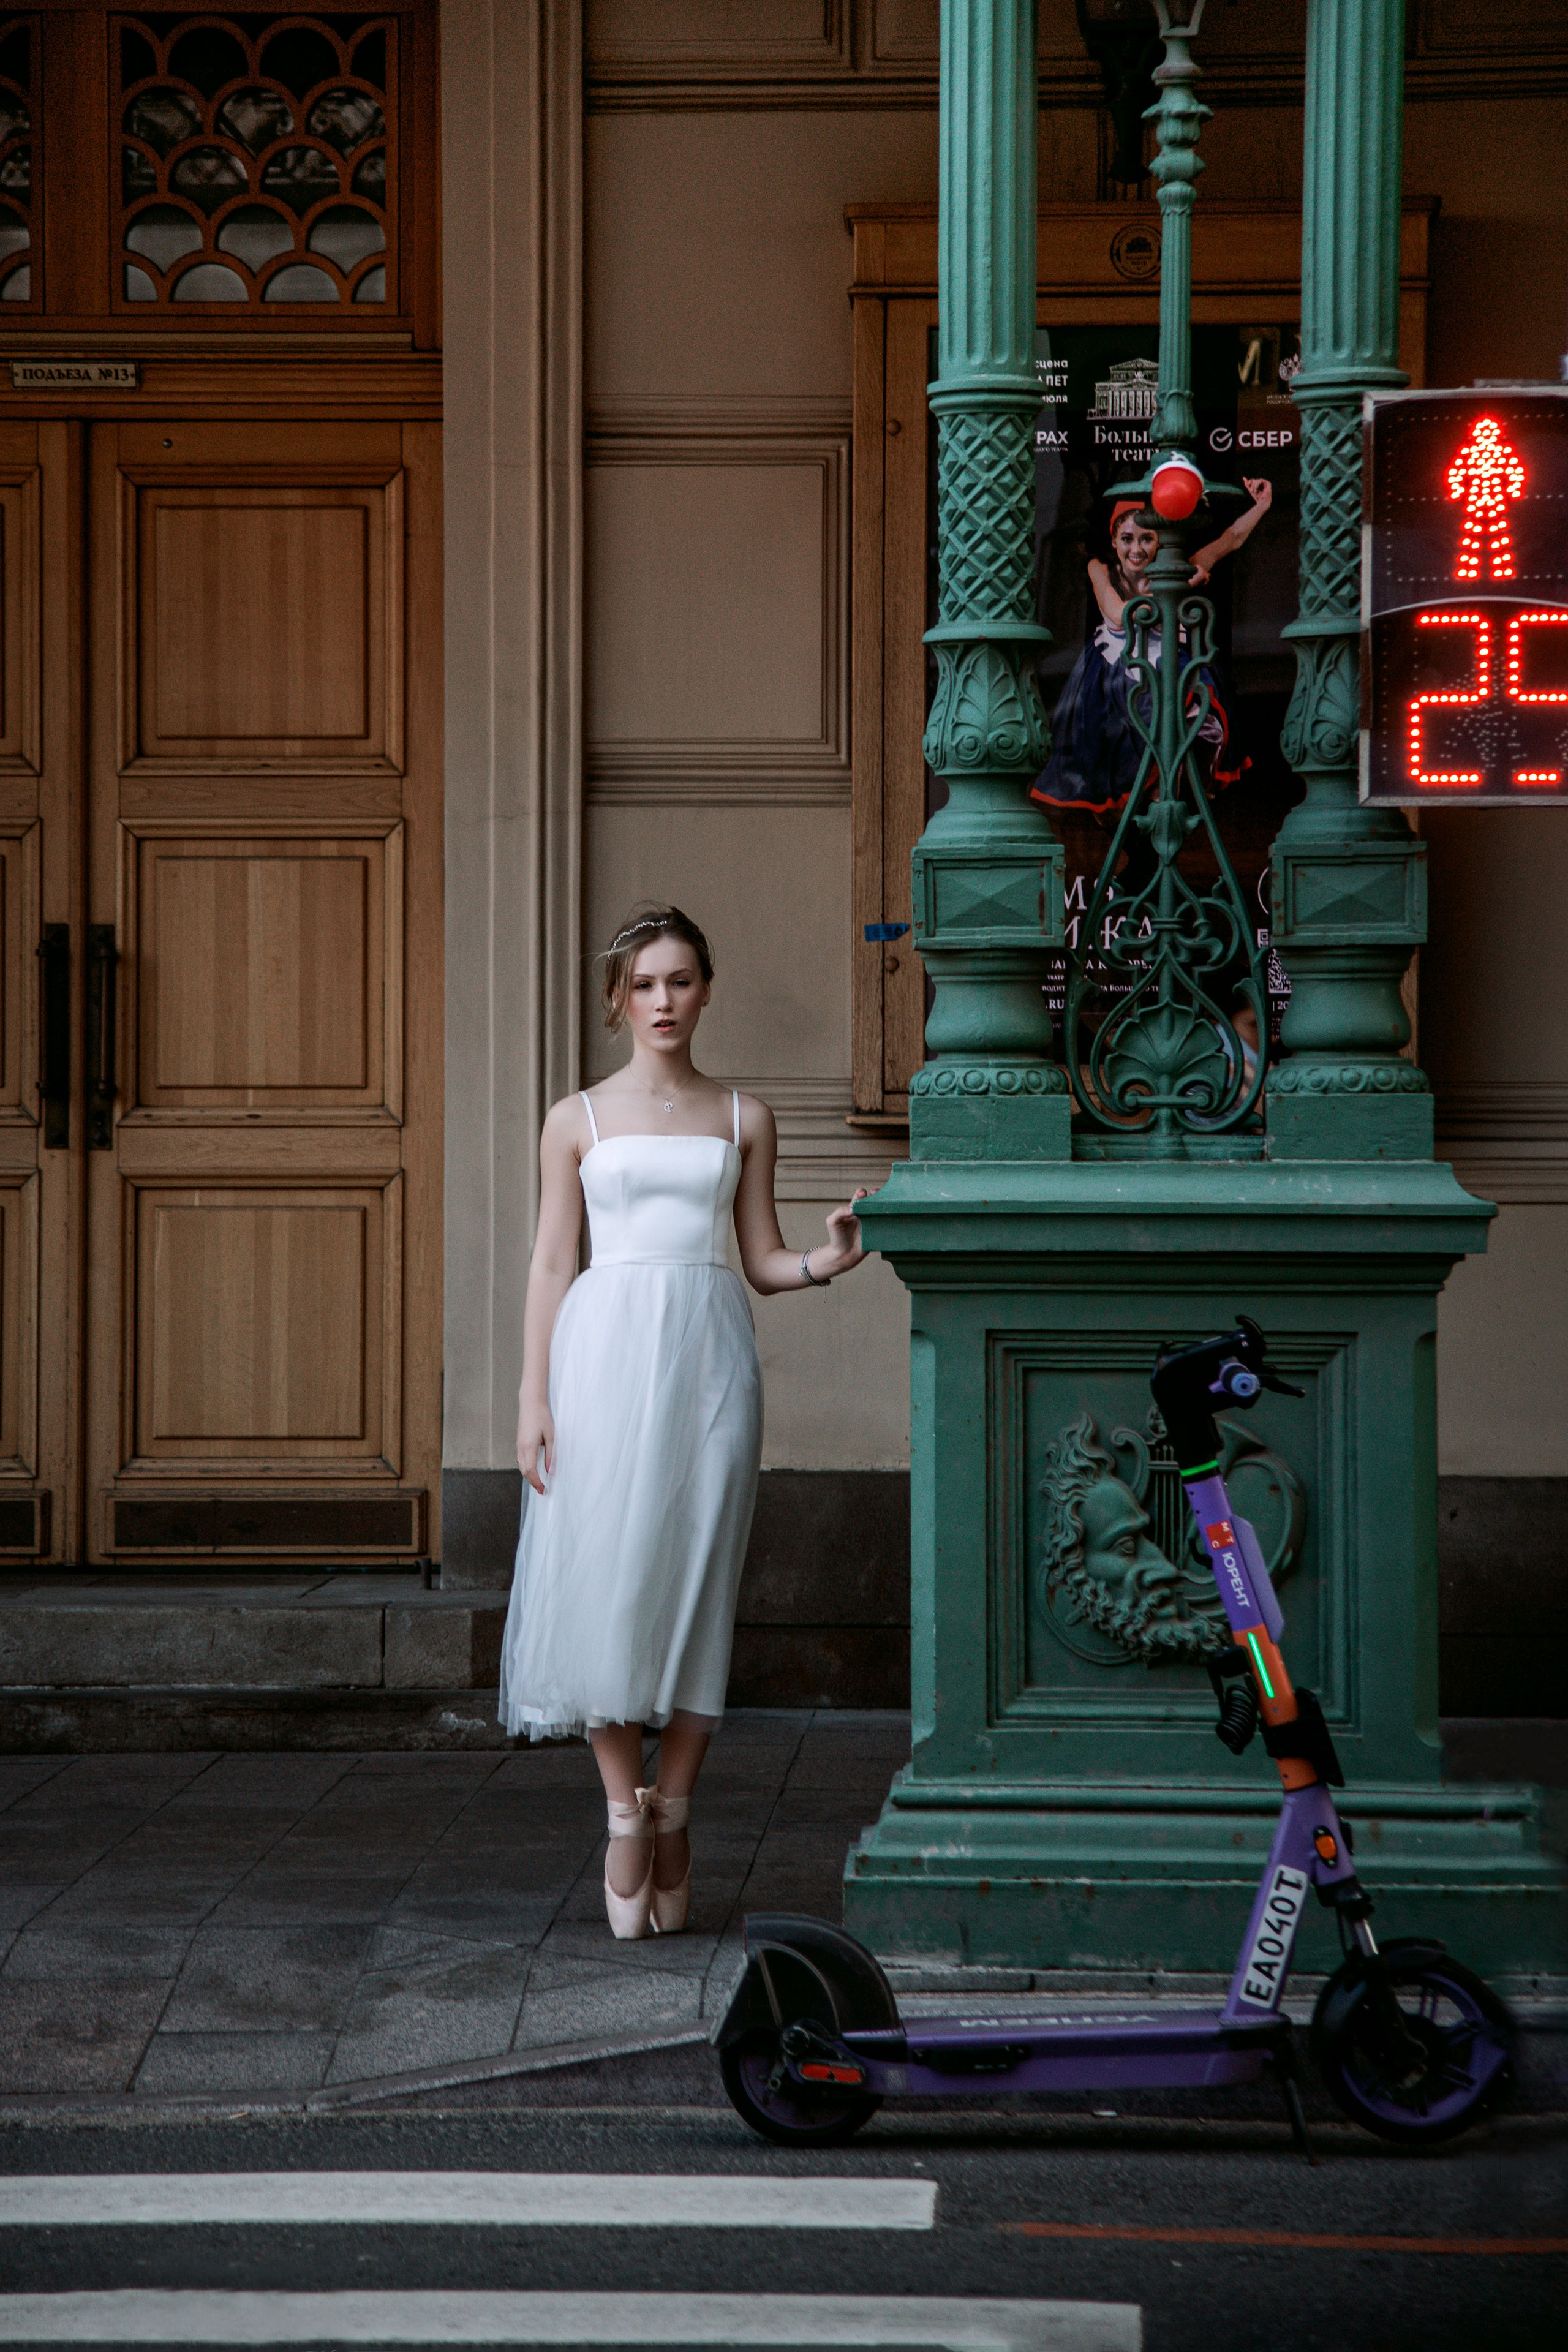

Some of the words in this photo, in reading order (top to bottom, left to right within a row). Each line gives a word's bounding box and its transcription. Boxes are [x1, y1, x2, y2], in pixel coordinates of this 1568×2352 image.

[1035, 430, 1068, 445] РАХ
[1238, 430, 1293, 448] СБЕР
[1111, 448, 1159, 462] теат
[1221, 1551, 1251, 1608] ЮРЕНТ
